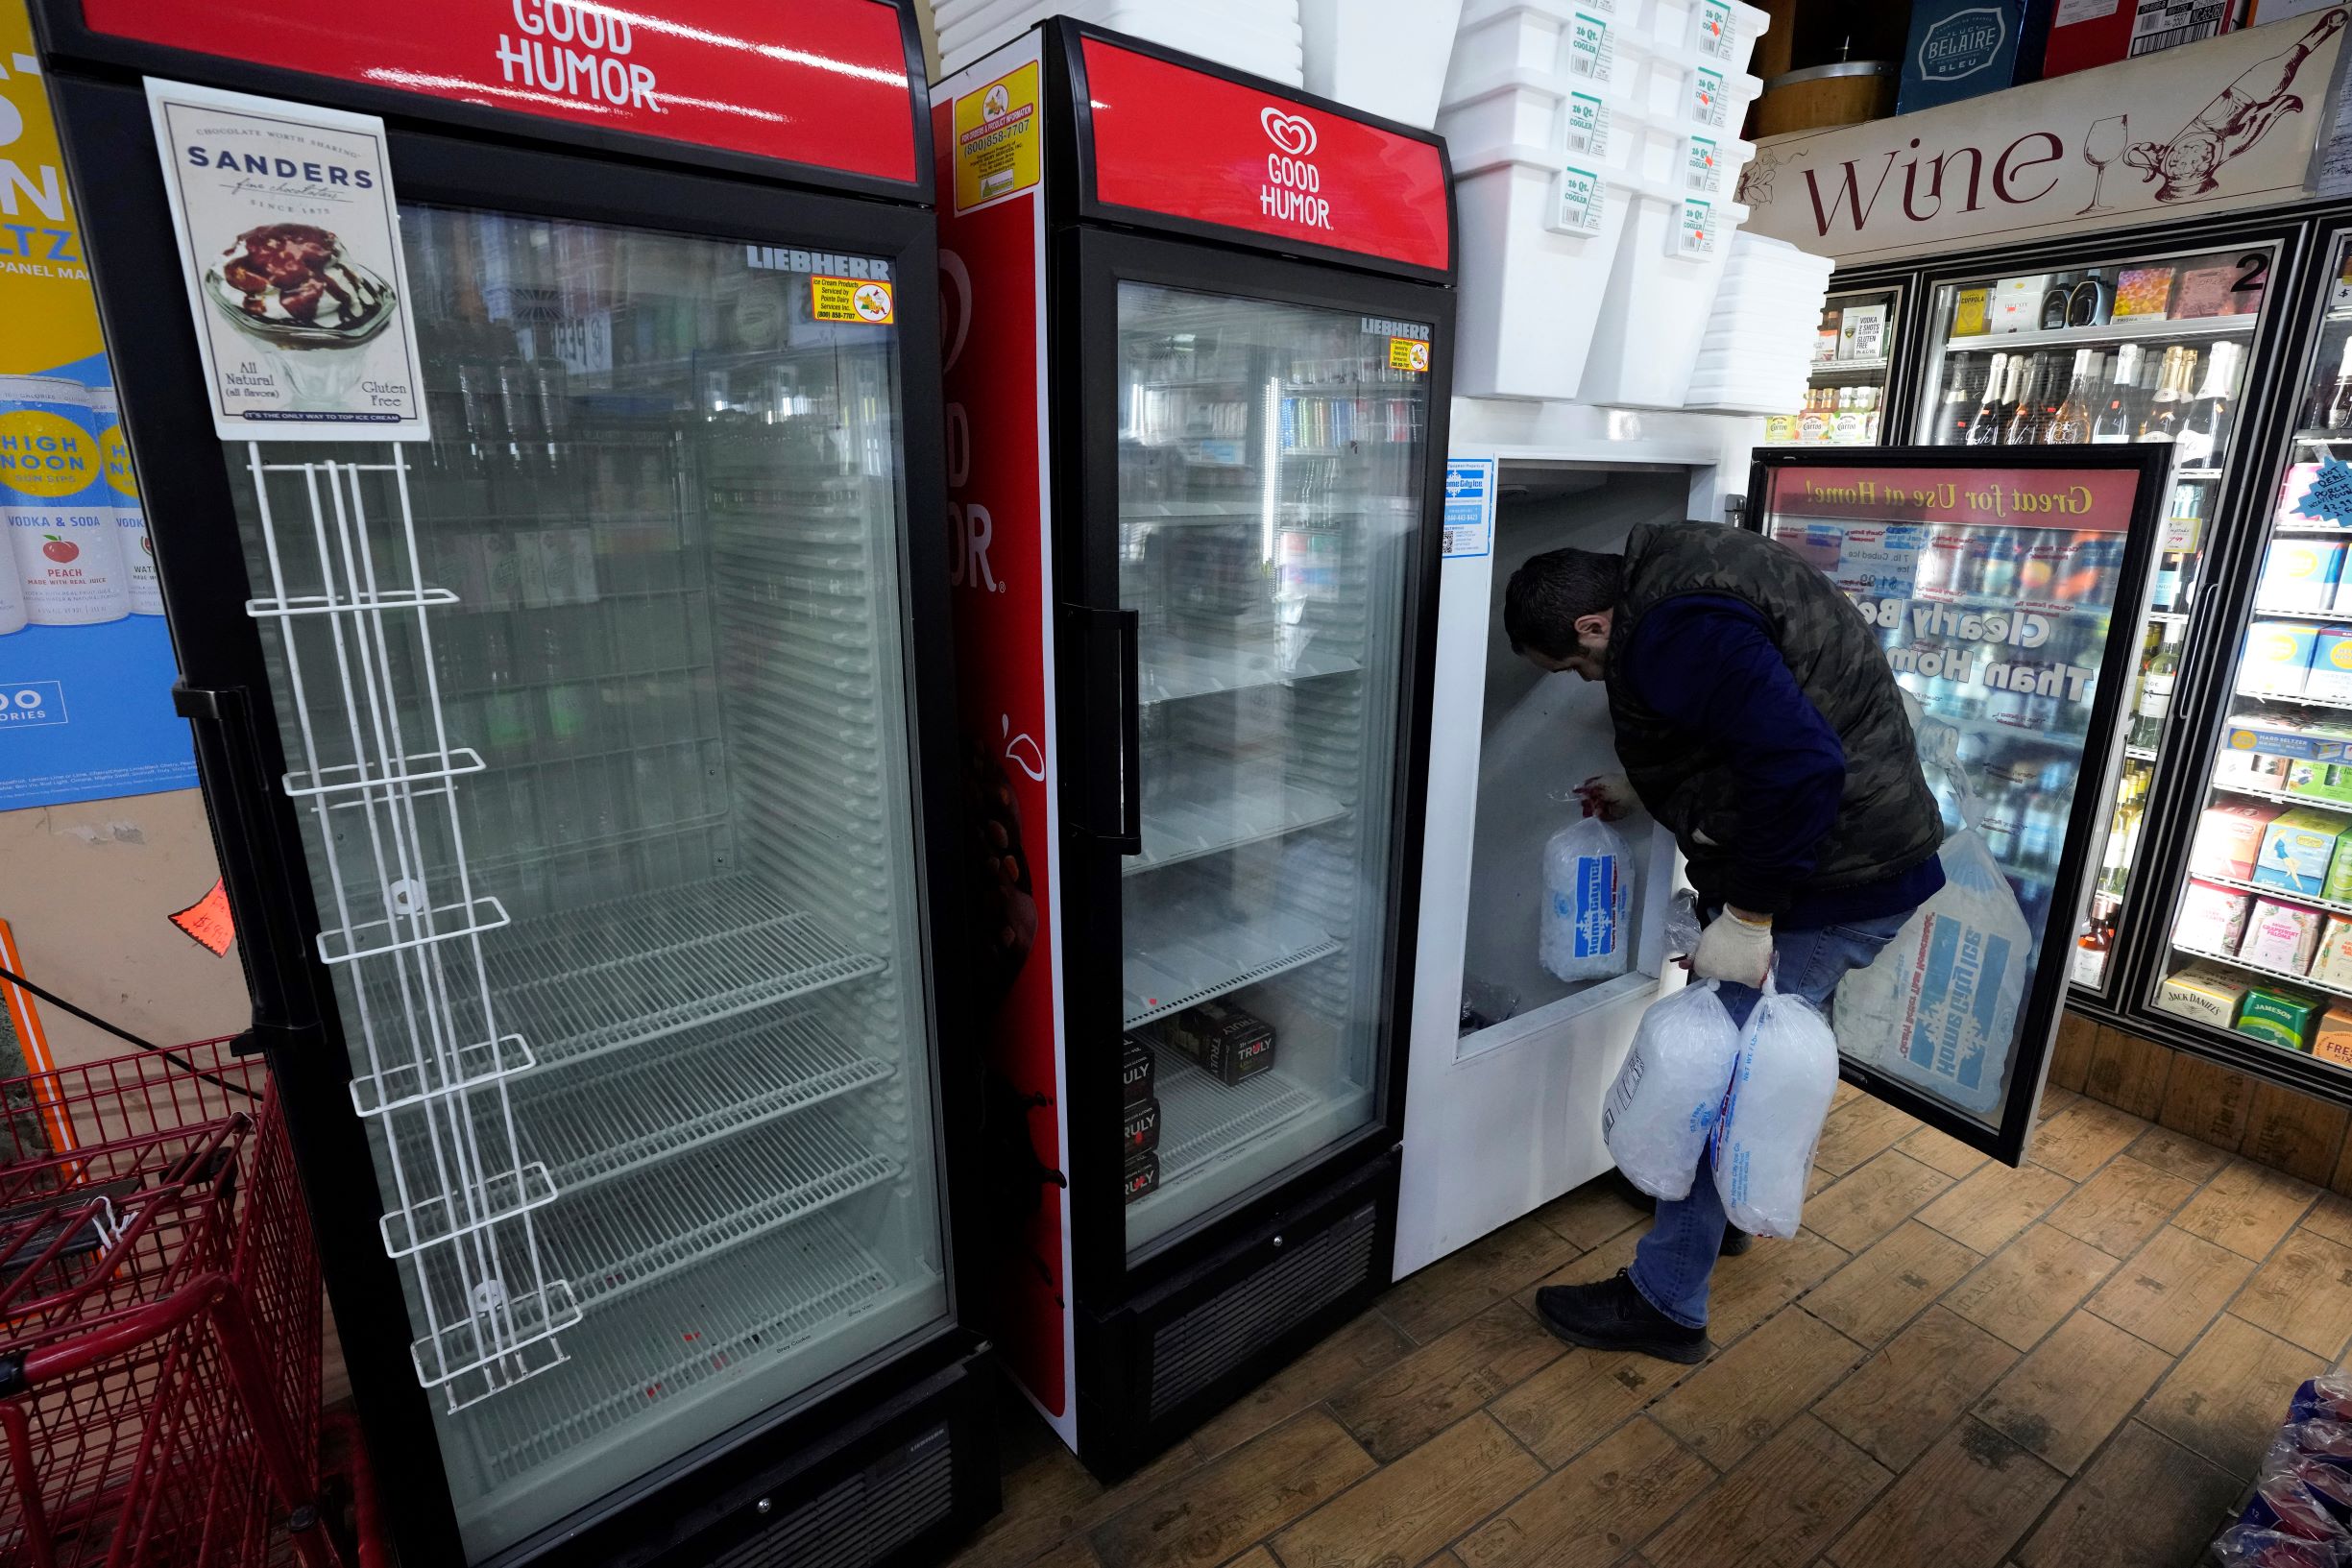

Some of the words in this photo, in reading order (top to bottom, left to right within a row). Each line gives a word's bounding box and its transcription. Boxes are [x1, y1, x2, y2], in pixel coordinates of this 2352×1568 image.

[1576, 27, 1586, 36] 26
[1587, 29, 1598, 40] Qt.
[1573, 40, 1596, 54] COOLER
[1928, 27, 1996, 59] BELAIRE
[1939, 59, 1976, 73] BLEU
[496, 35, 662, 113] HUMOR
[1572, 105, 1582, 113] 26
[1583, 106, 1593, 117] Qt.
[1569, 117, 1592, 131] COOLER
[196, 128, 262, 137] CHOCOLATE
[266, 131, 305, 143] WORTH
[310, 139, 357, 158] SHARING
[187, 146, 374, 189] SANDERS
[1689, 159, 1709, 170] COOLER
[1268, 153, 1320, 194] GOOD
[1567, 180, 1577, 188] 26
[1578, 181, 1589, 192] Qt.
[1802, 132, 2063, 236] Wine
[1564, 192, 1588, 205] COOLER
[250, 199, 295, 213] SINCE
[1260, 183, 1331, 230] HUMOR
[1683, 222, 1703, 230] COOLER
[746, 245, 891, 281] LIEBHERR
[2230, 253, 2269, 293] 2
[820, 302, 841, 311] Services
[1859, 316, 1878, 325] VODKA
[1361, 317, 1430, 341] LIEBHERR
[1863, 324, 1880, 332] SHOTS
[1856, 335, 1877, 344] GLUTEN
[239, 362, 257, 374] All
[226, 373, 275, 386] Natural
[226, 388, 241, 398] (all
[243, 388, 279, 398] flavors)
[361, 381, 407, 395] Gluten
[371, 395, 402, 407] Free
[2, 435, 78, 452] HIGH
[1, 454, 85, 471] NOON
[15, 474, 42, 483] SUN
[2318, 466, 2340, 479] HOT
[1460, 480, 1473, 489] City
[2315, 483, 2350, 499] PORCH
[8, 516, 50, 527] VODKA
[56, 517, 66, 527] &
[71, 516, 101, 527] SODA
[116, 518, 145, 528] VODK
[48, 568, 83, 577] PEACH
[1589, 882, 1601, 911] City
[1588, 913, 1600, 955] Home
[2262, 924, 2300, 939] GRAPEFRUIT
[2253, 1003, 2293, 1021] JAMESON
[1222, 1018, 1259, 1036] TRULY
[1210, 1038, 1222, 1073] TRULY
[1237, 1038, 1273, 1061] TRULY
[1123, 1063, 1150, 1085] ULY
[1742, 1067, 1751, 1082] NET
[1124, 1114, 1155, 1138] RULY
[1125, 1170, 1154, 1195] RULY
